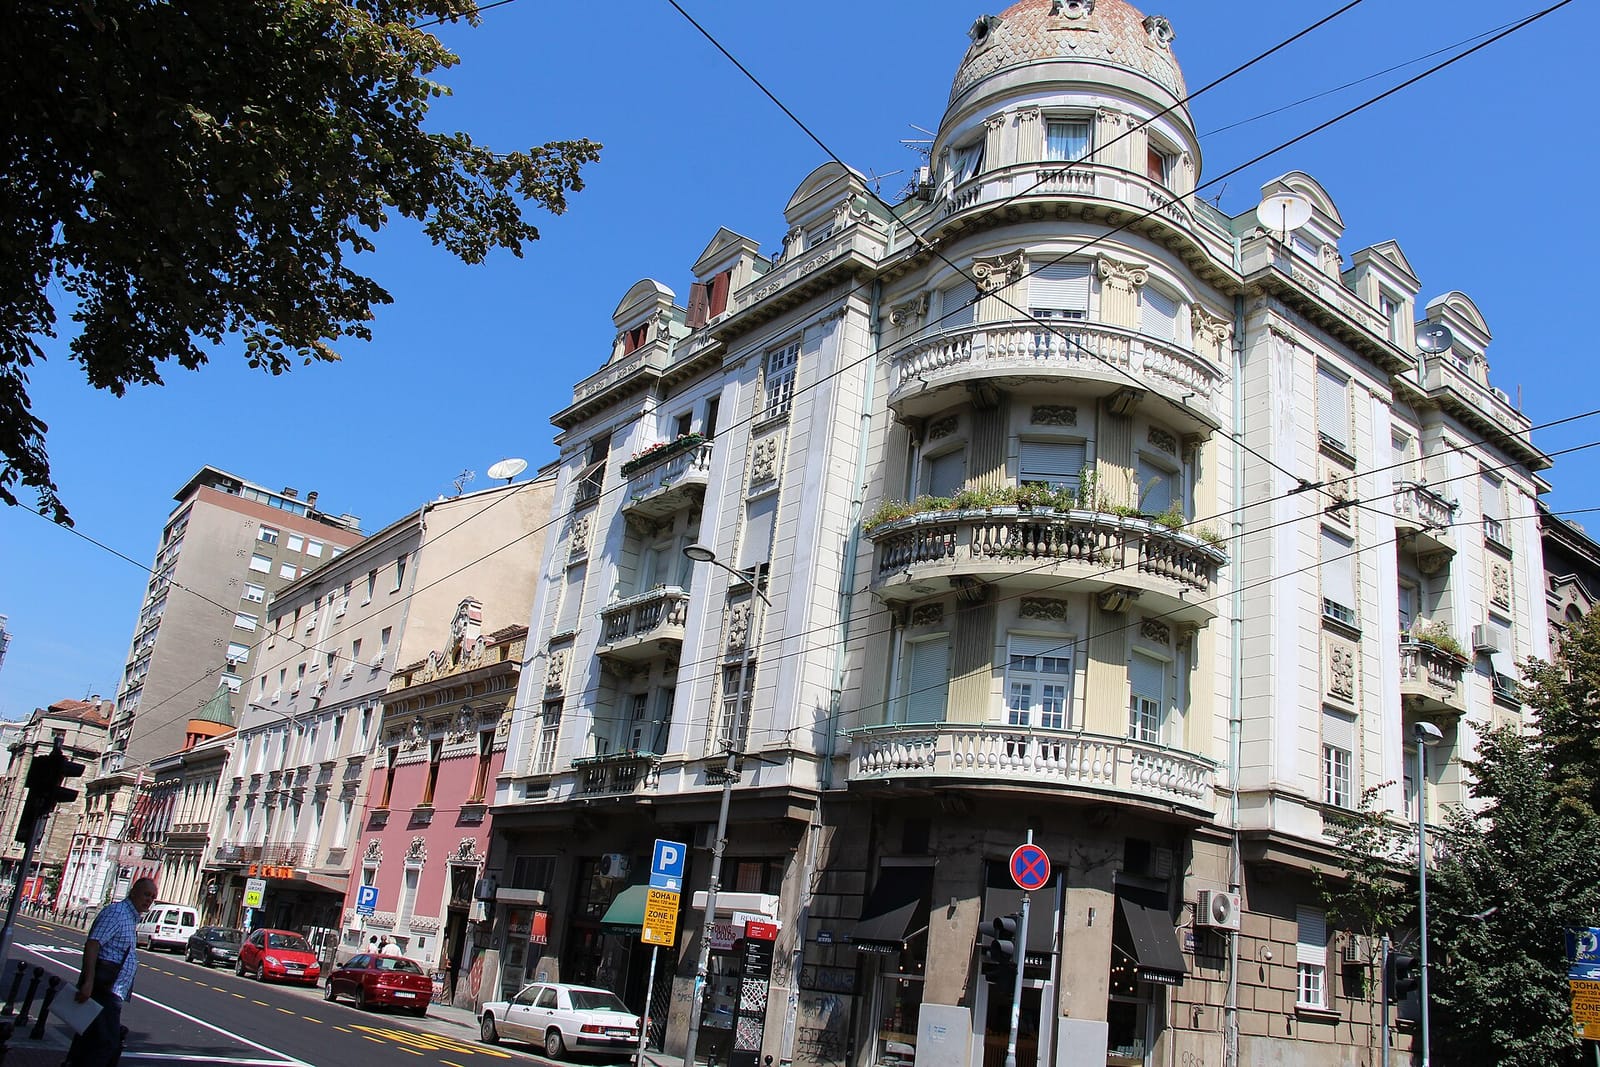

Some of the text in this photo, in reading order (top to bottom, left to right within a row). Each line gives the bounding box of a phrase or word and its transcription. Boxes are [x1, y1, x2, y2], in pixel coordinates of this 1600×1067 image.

[660, 846, 678, 870] P
[361, 888, 374, 904] P
[648, 910, 668, 920] ZONE
[1573, 981, 1600, 990] ЗОНА
[1575, 1002, 1600, 1012] ZONE
